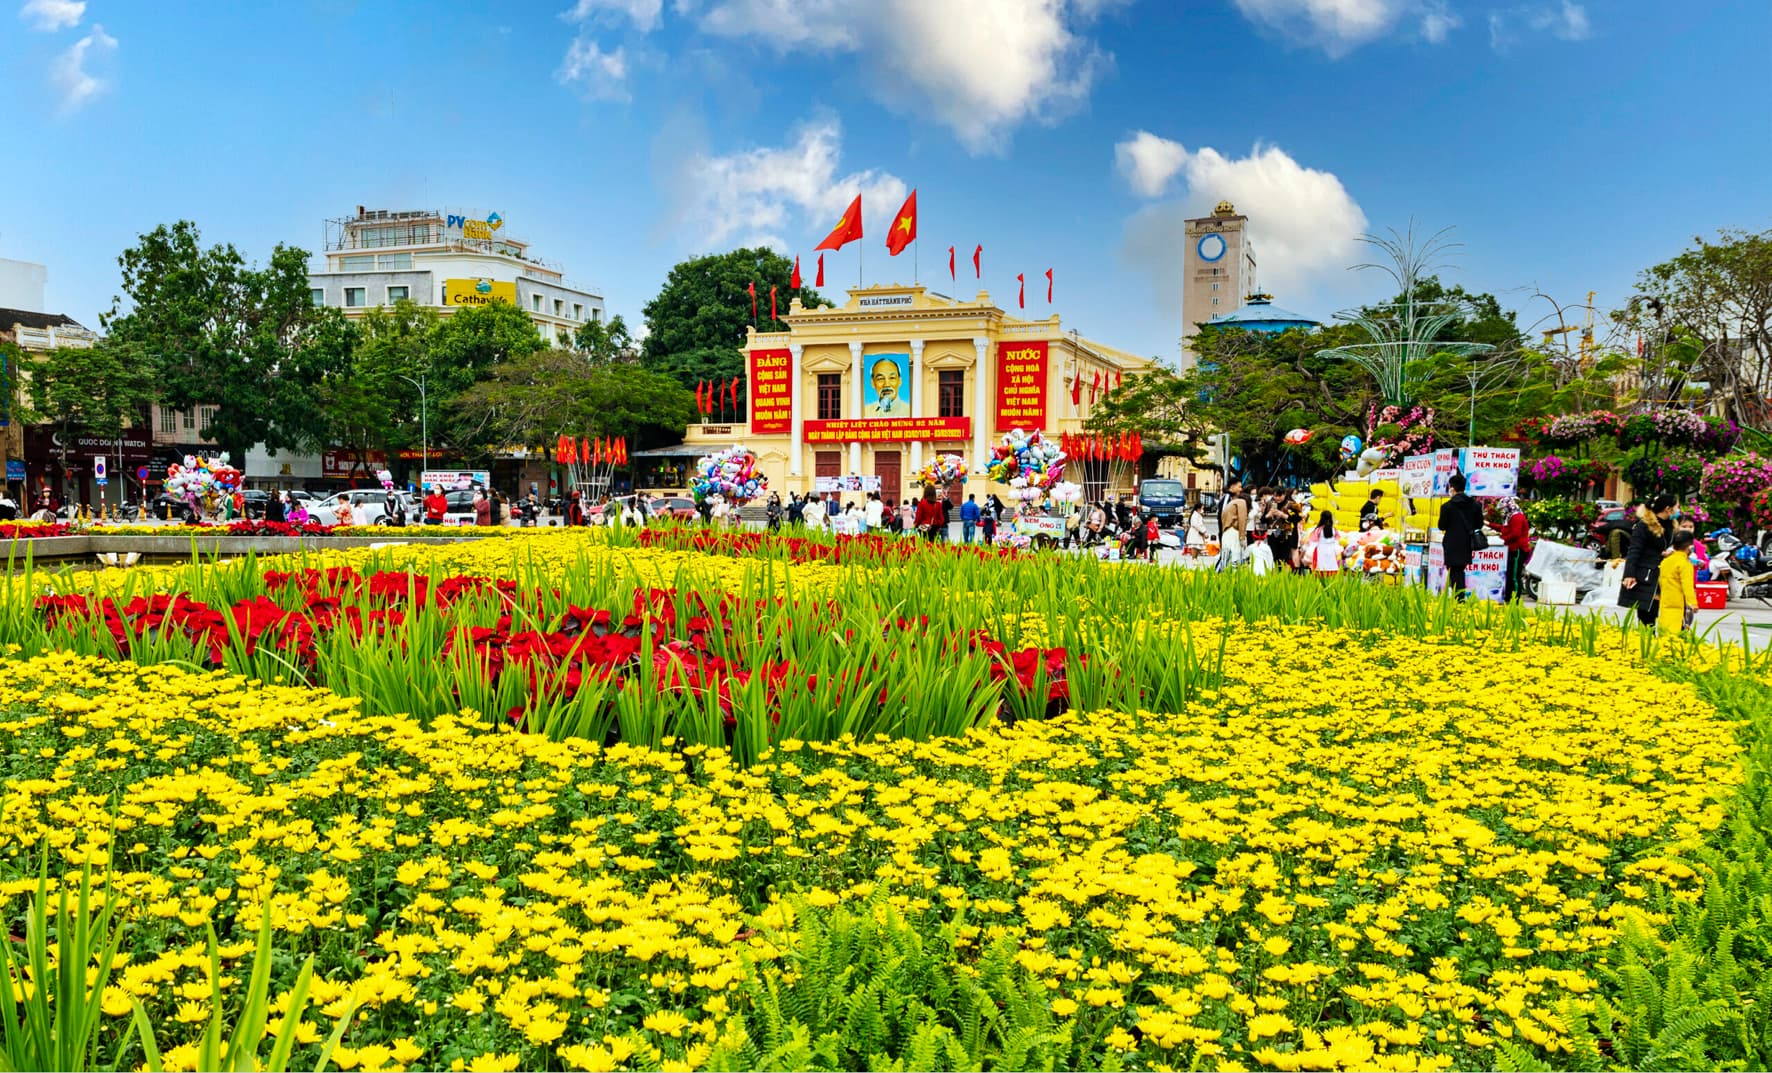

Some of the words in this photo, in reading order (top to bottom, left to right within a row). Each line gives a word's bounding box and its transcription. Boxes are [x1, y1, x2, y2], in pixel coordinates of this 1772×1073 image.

[757, 354, 787, 368] ĐẢNG
[759, 383, 771, 395] VIỆT
[772, 384, 786, 393] NAM
[755, 397, 775, 408] QUANG
[776, 397, 791, 406] VINH
[1006, 397, 1020, 406] VIỆT
[1021, 397, 1038, 405] NAM
